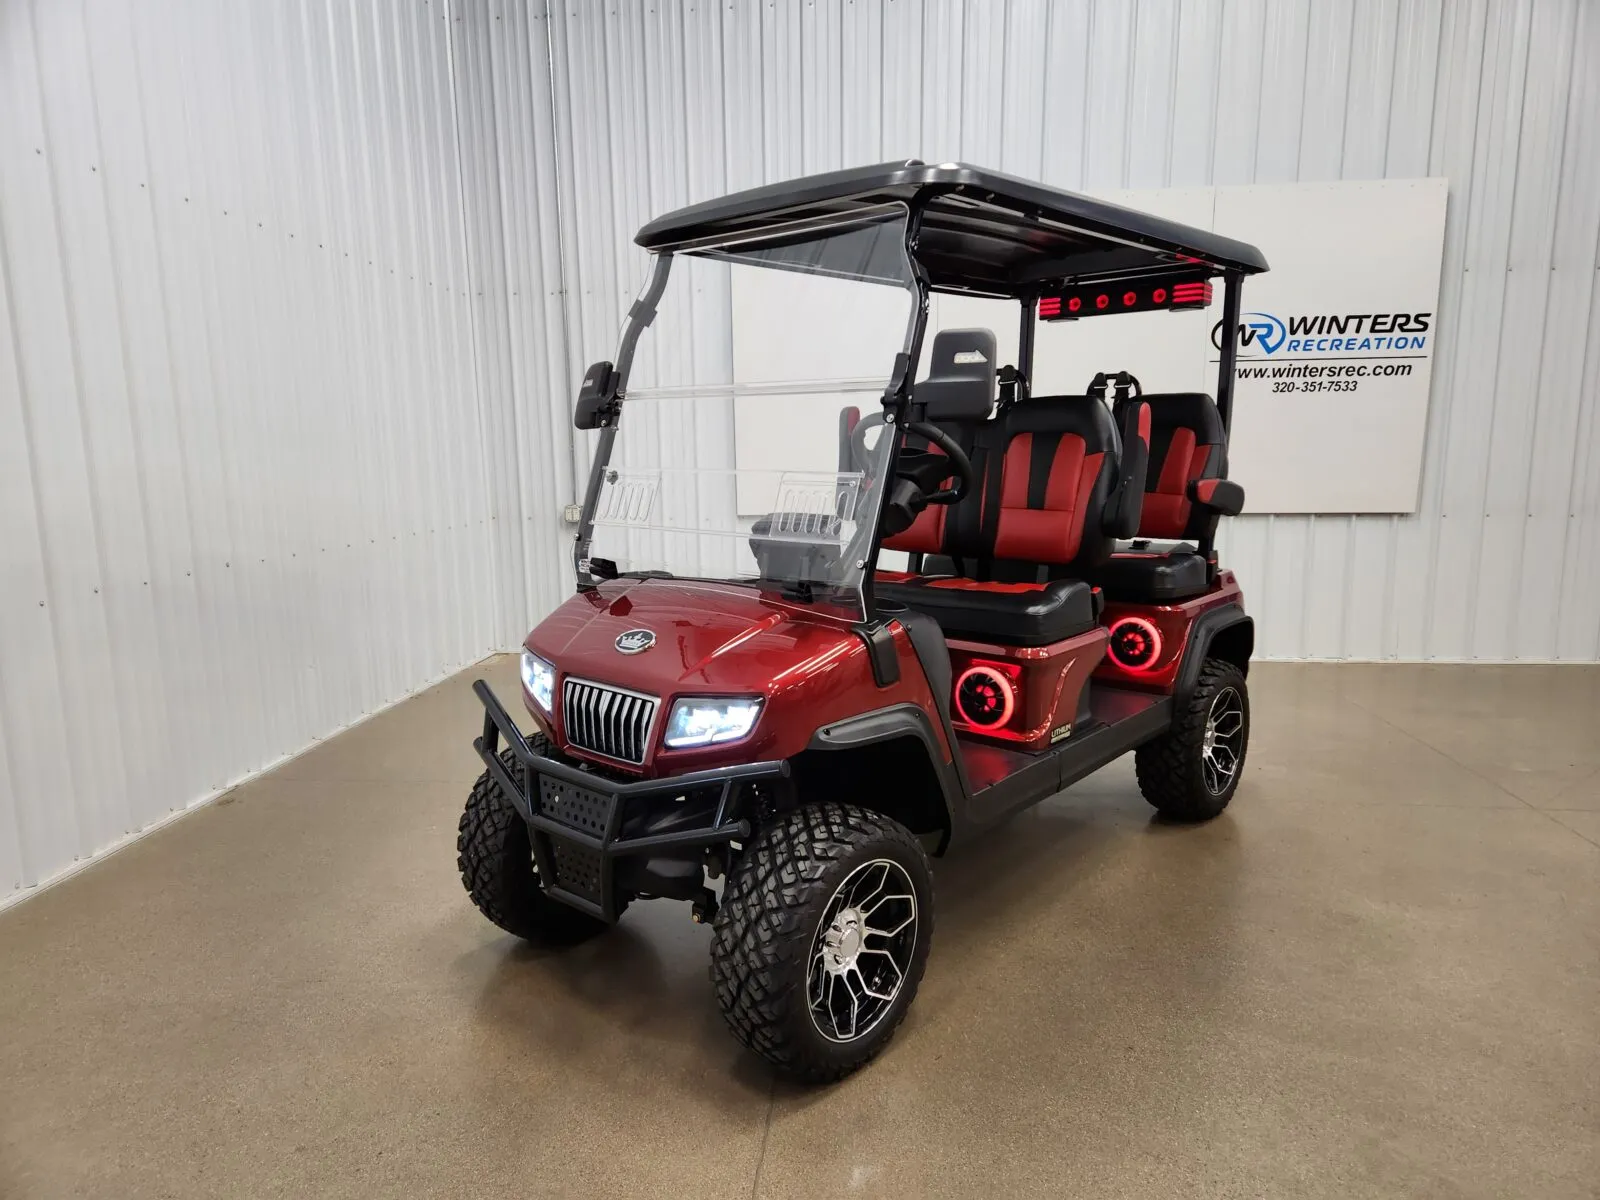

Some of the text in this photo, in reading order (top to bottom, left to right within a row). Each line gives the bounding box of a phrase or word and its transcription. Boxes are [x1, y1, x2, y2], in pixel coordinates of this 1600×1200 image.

[1289, 313, 1431, 335] WINTERS
[1287, 337, 1426, 352] RECREATION
[1234, 363, 1412, 378] ww.wintersrec.com
[1272, 381, 1358, 393] 320-351-7533
